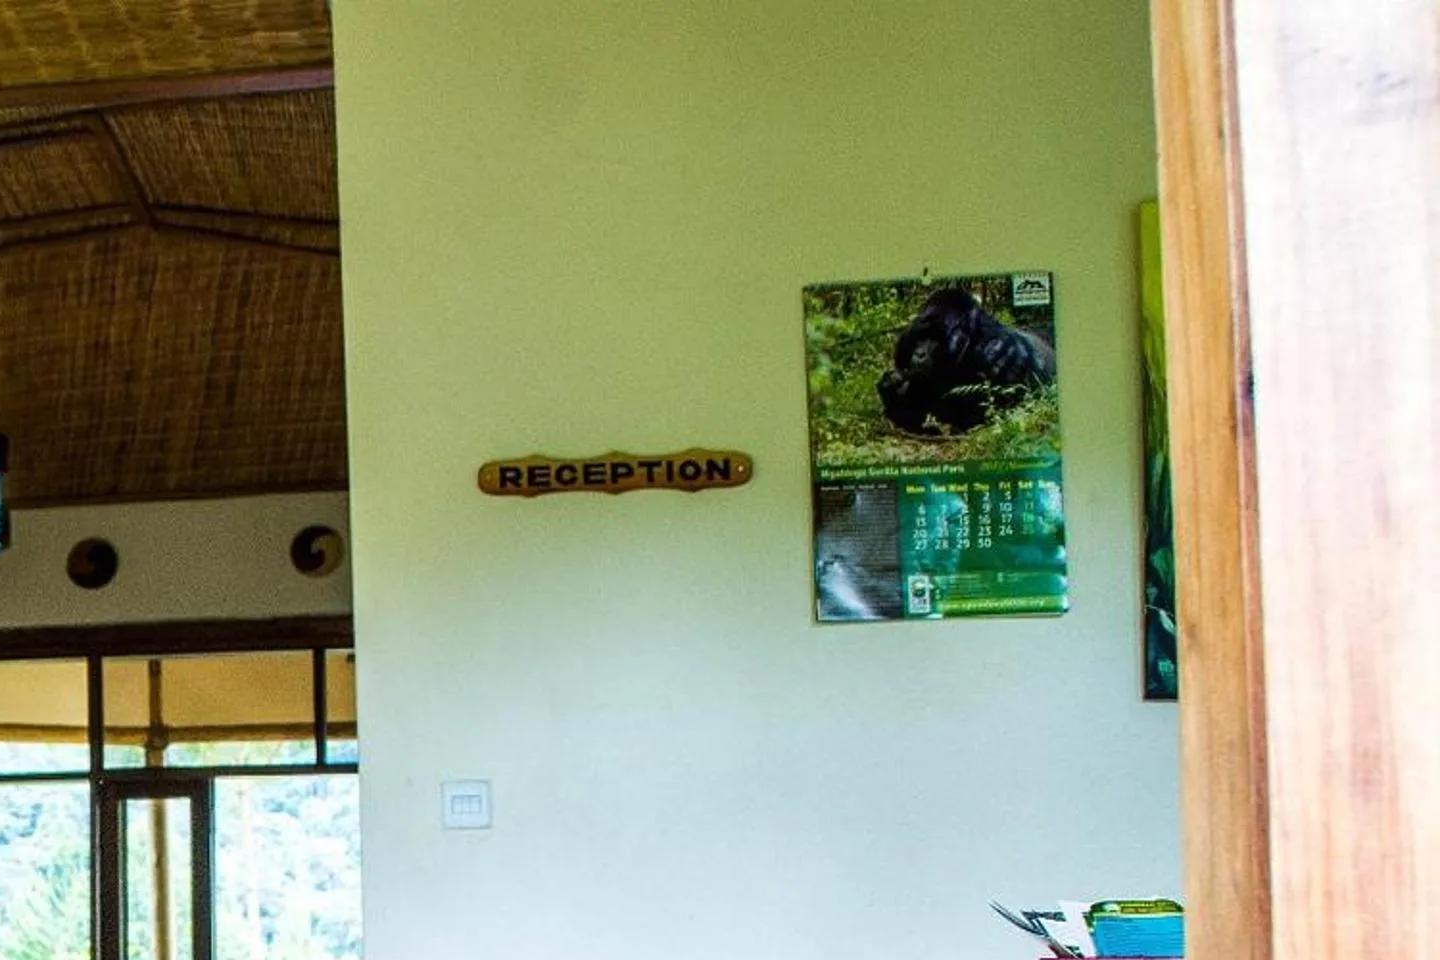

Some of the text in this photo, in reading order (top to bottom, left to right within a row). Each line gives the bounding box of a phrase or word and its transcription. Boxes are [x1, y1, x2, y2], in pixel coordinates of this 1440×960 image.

[499, 459, 731, 488] RECEPTION
[868, 467, 899, 476] Gorilla
[901, 465, 942, 475] National
[943, 464, 965, 474] Park
[998, 502, 1013, 511] 10
